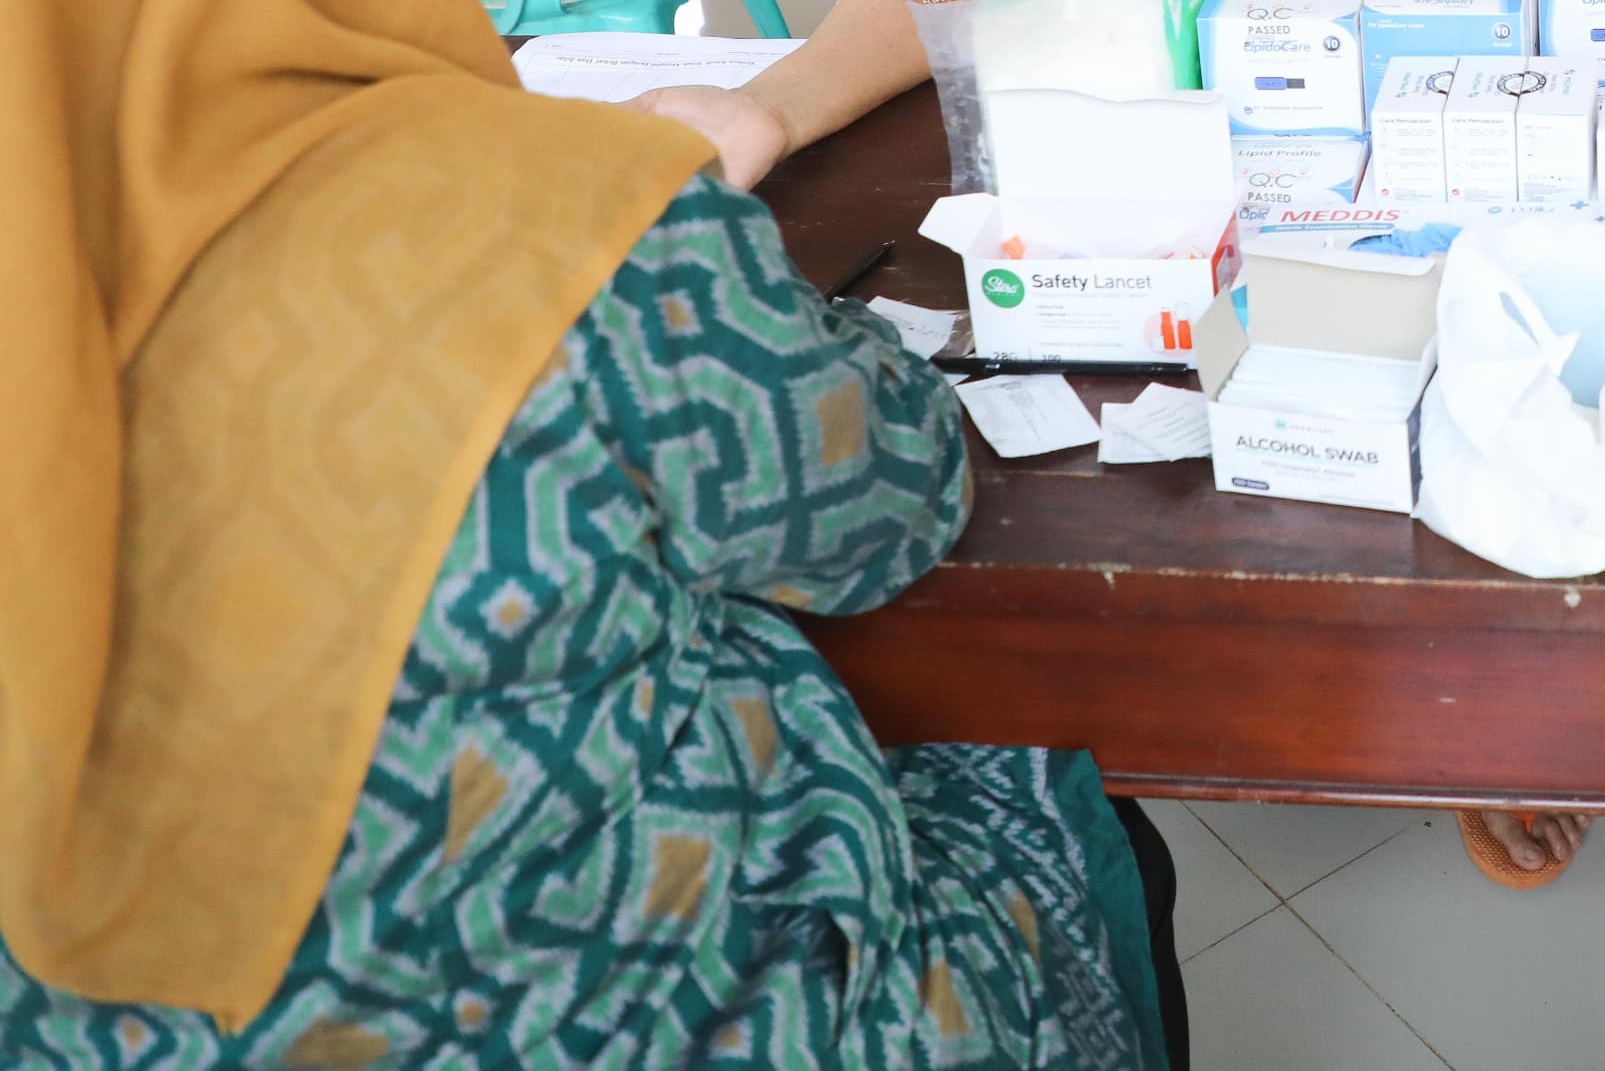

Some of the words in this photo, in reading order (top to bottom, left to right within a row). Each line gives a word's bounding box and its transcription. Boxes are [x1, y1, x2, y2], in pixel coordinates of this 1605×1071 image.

[1247, 7, 1294, 21] Q.C
[1248, 25, 1290, 34] PASSED
[1496, 26, 1509, 36] 10
[1243, 40, 1311, 53] LipidoCare
[1325, 39, 1339, 49] 10
[1238, 150, 1274, 158] Lipid
[1249, 172, 1295, 188] Q.C
[1247, 192, 1291, 203] PASSED
[1280, 210, 1400, 222] MEDDIS
[1032, 274, 1088, 291] Safety
[1094, 273, 1152, 289] Lancet
[1236, 436, 1320, 459] ALCOHOL
[1325, 448, 1378, 464] SWAB
